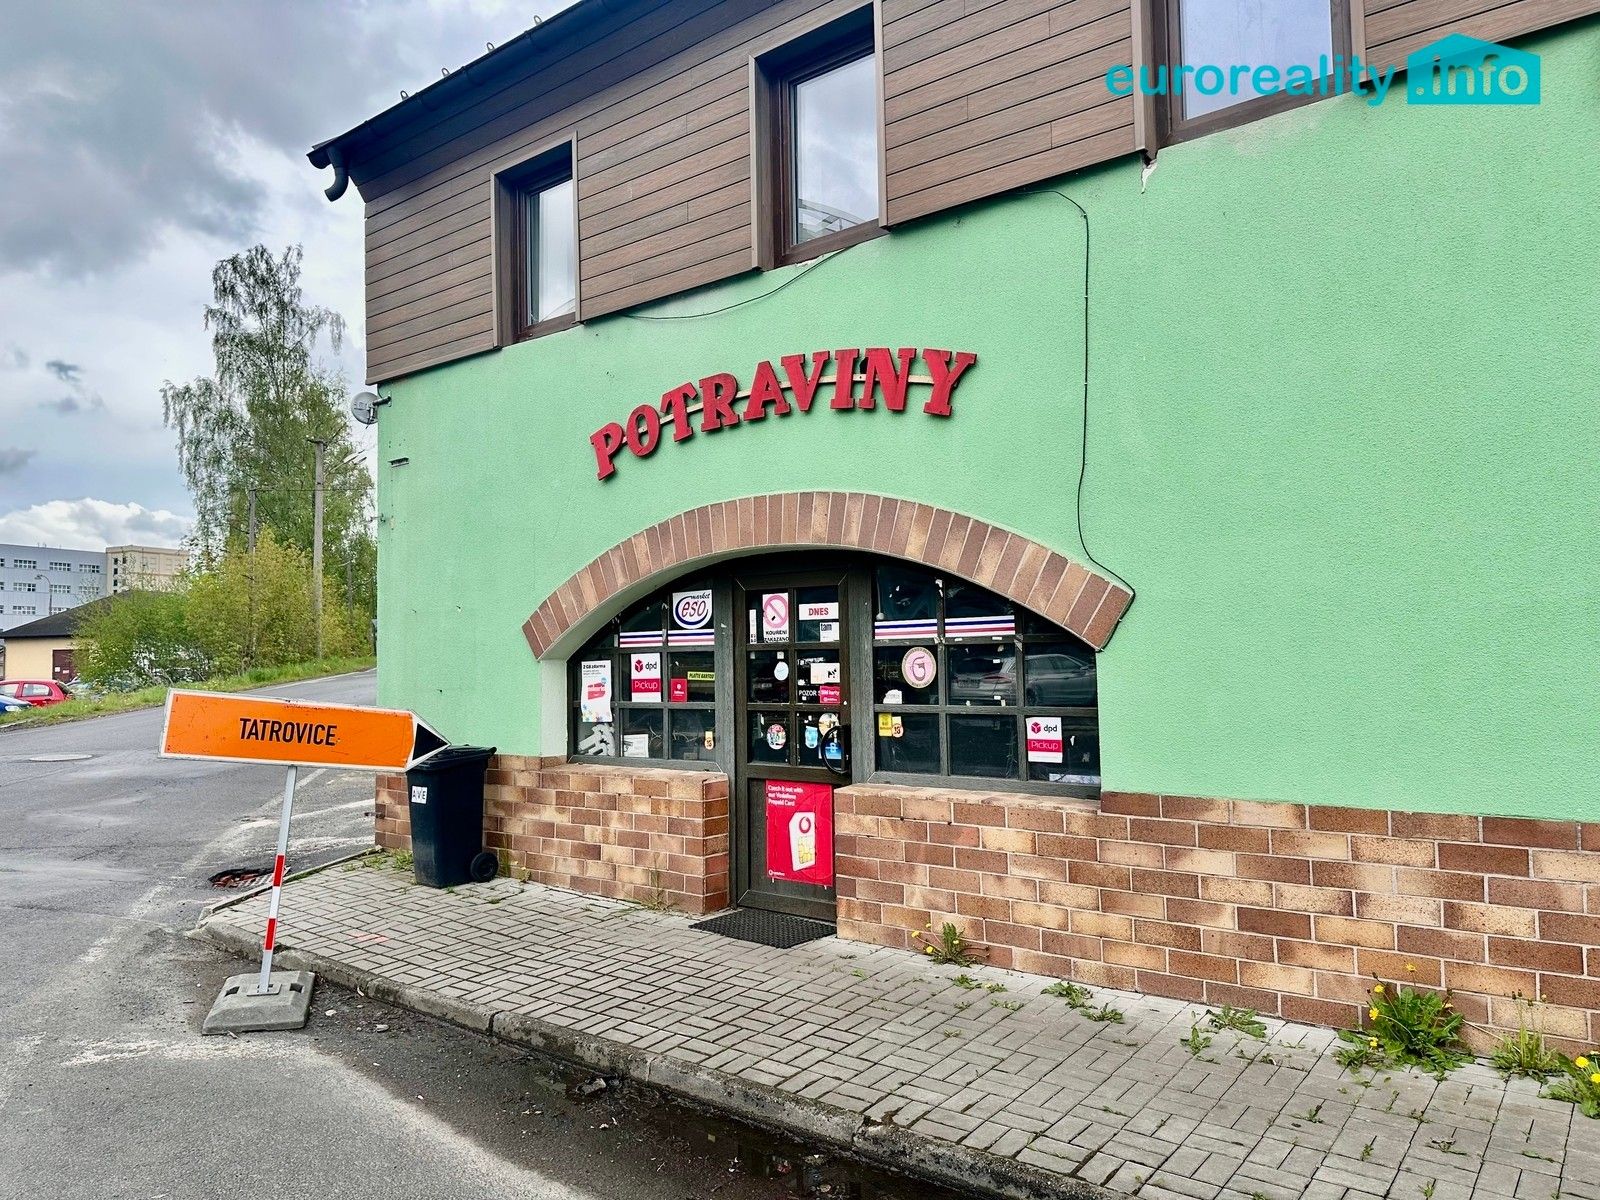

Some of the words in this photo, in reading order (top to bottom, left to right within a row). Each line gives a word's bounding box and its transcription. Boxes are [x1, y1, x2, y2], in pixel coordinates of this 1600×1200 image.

[589, 347, 977, 480] POTRAVINY
[681, 600, 707, 617] eso
[808, 607, 829, 616] DNES
[645, 661, 658, 671] dpd
[634, 679, 658, 691] Pickup
[239, 718, 338, 747] TATROVICE
[1043, 724, 1058, 733] dpd
[1031, 740, 1059, 751] Pickup
